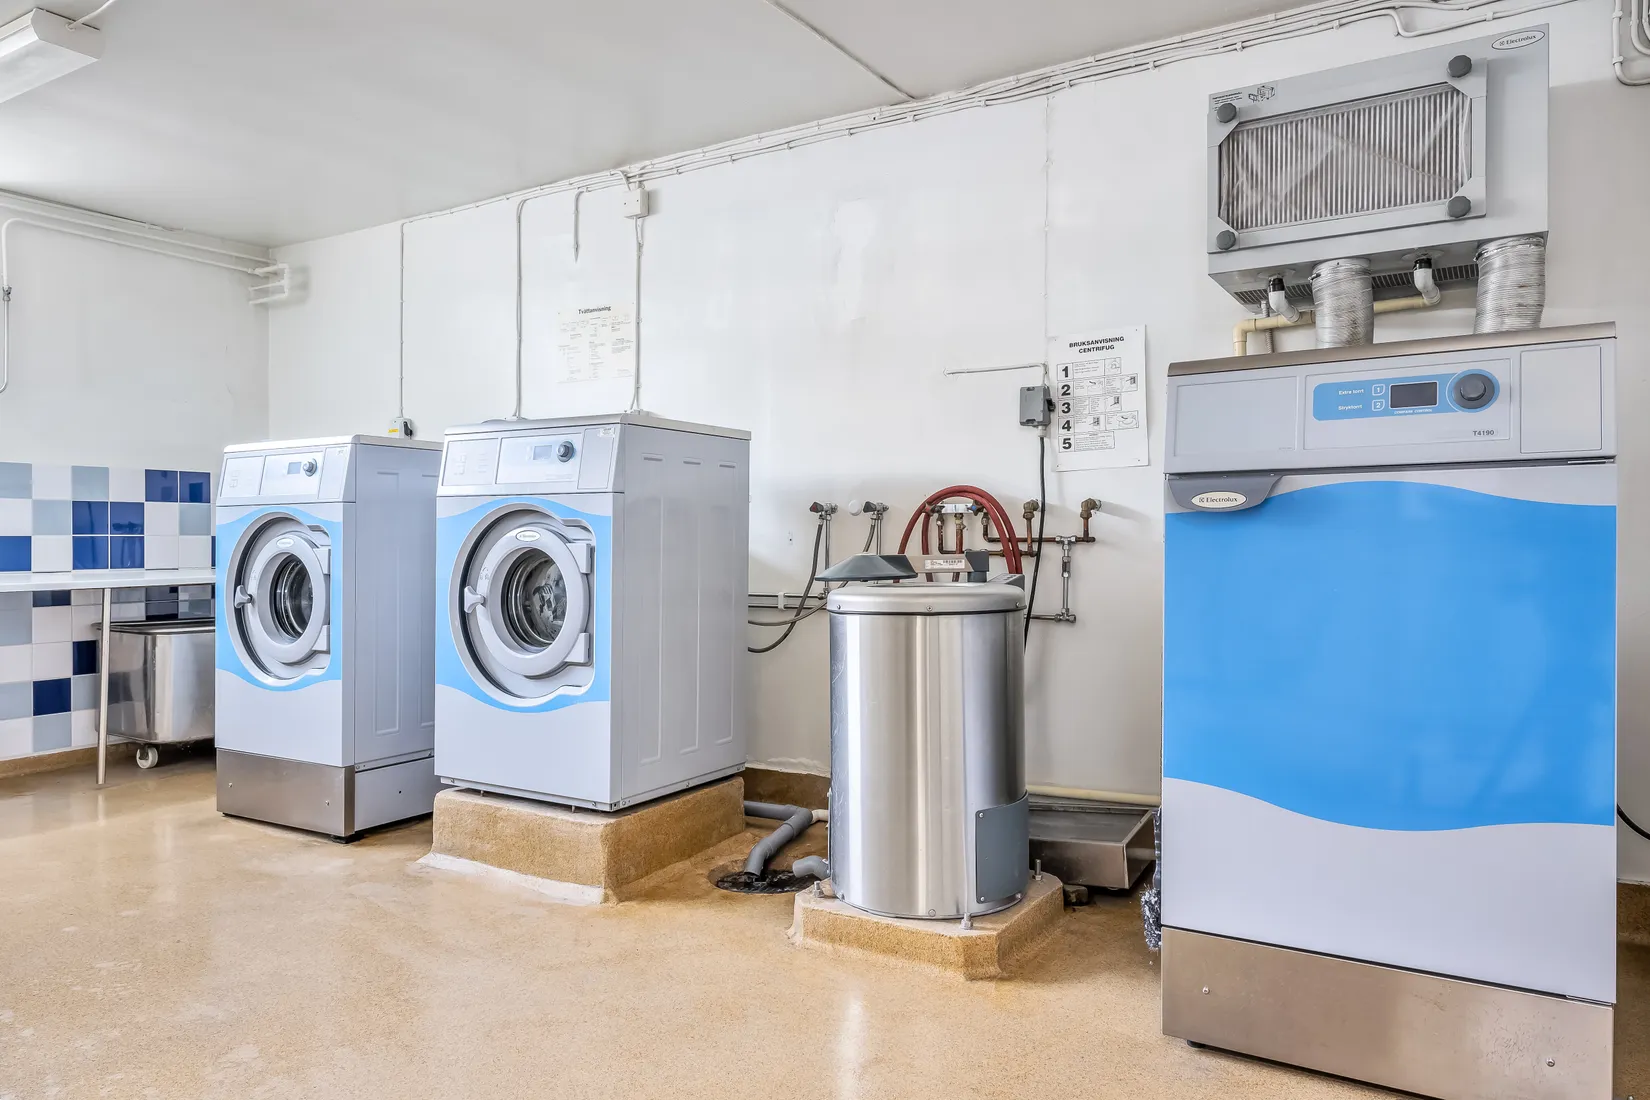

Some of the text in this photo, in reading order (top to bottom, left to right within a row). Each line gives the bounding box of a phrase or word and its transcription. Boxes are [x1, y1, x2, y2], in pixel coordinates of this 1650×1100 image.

[1506, 35, 1536, 45] Electrolux
[1069, 336, 1124, 348] BRUKSANVISNING
[1078, 344, 1115, 353] CENTRIFUG
[1062, 366, 1068, 378] 1
[1061, 384, 1070, 396] 2
[1061, 402, 1071, 414] 3
[1061, 420, 1071, 431] 4
[1062, 438, 1072, 450] 5
